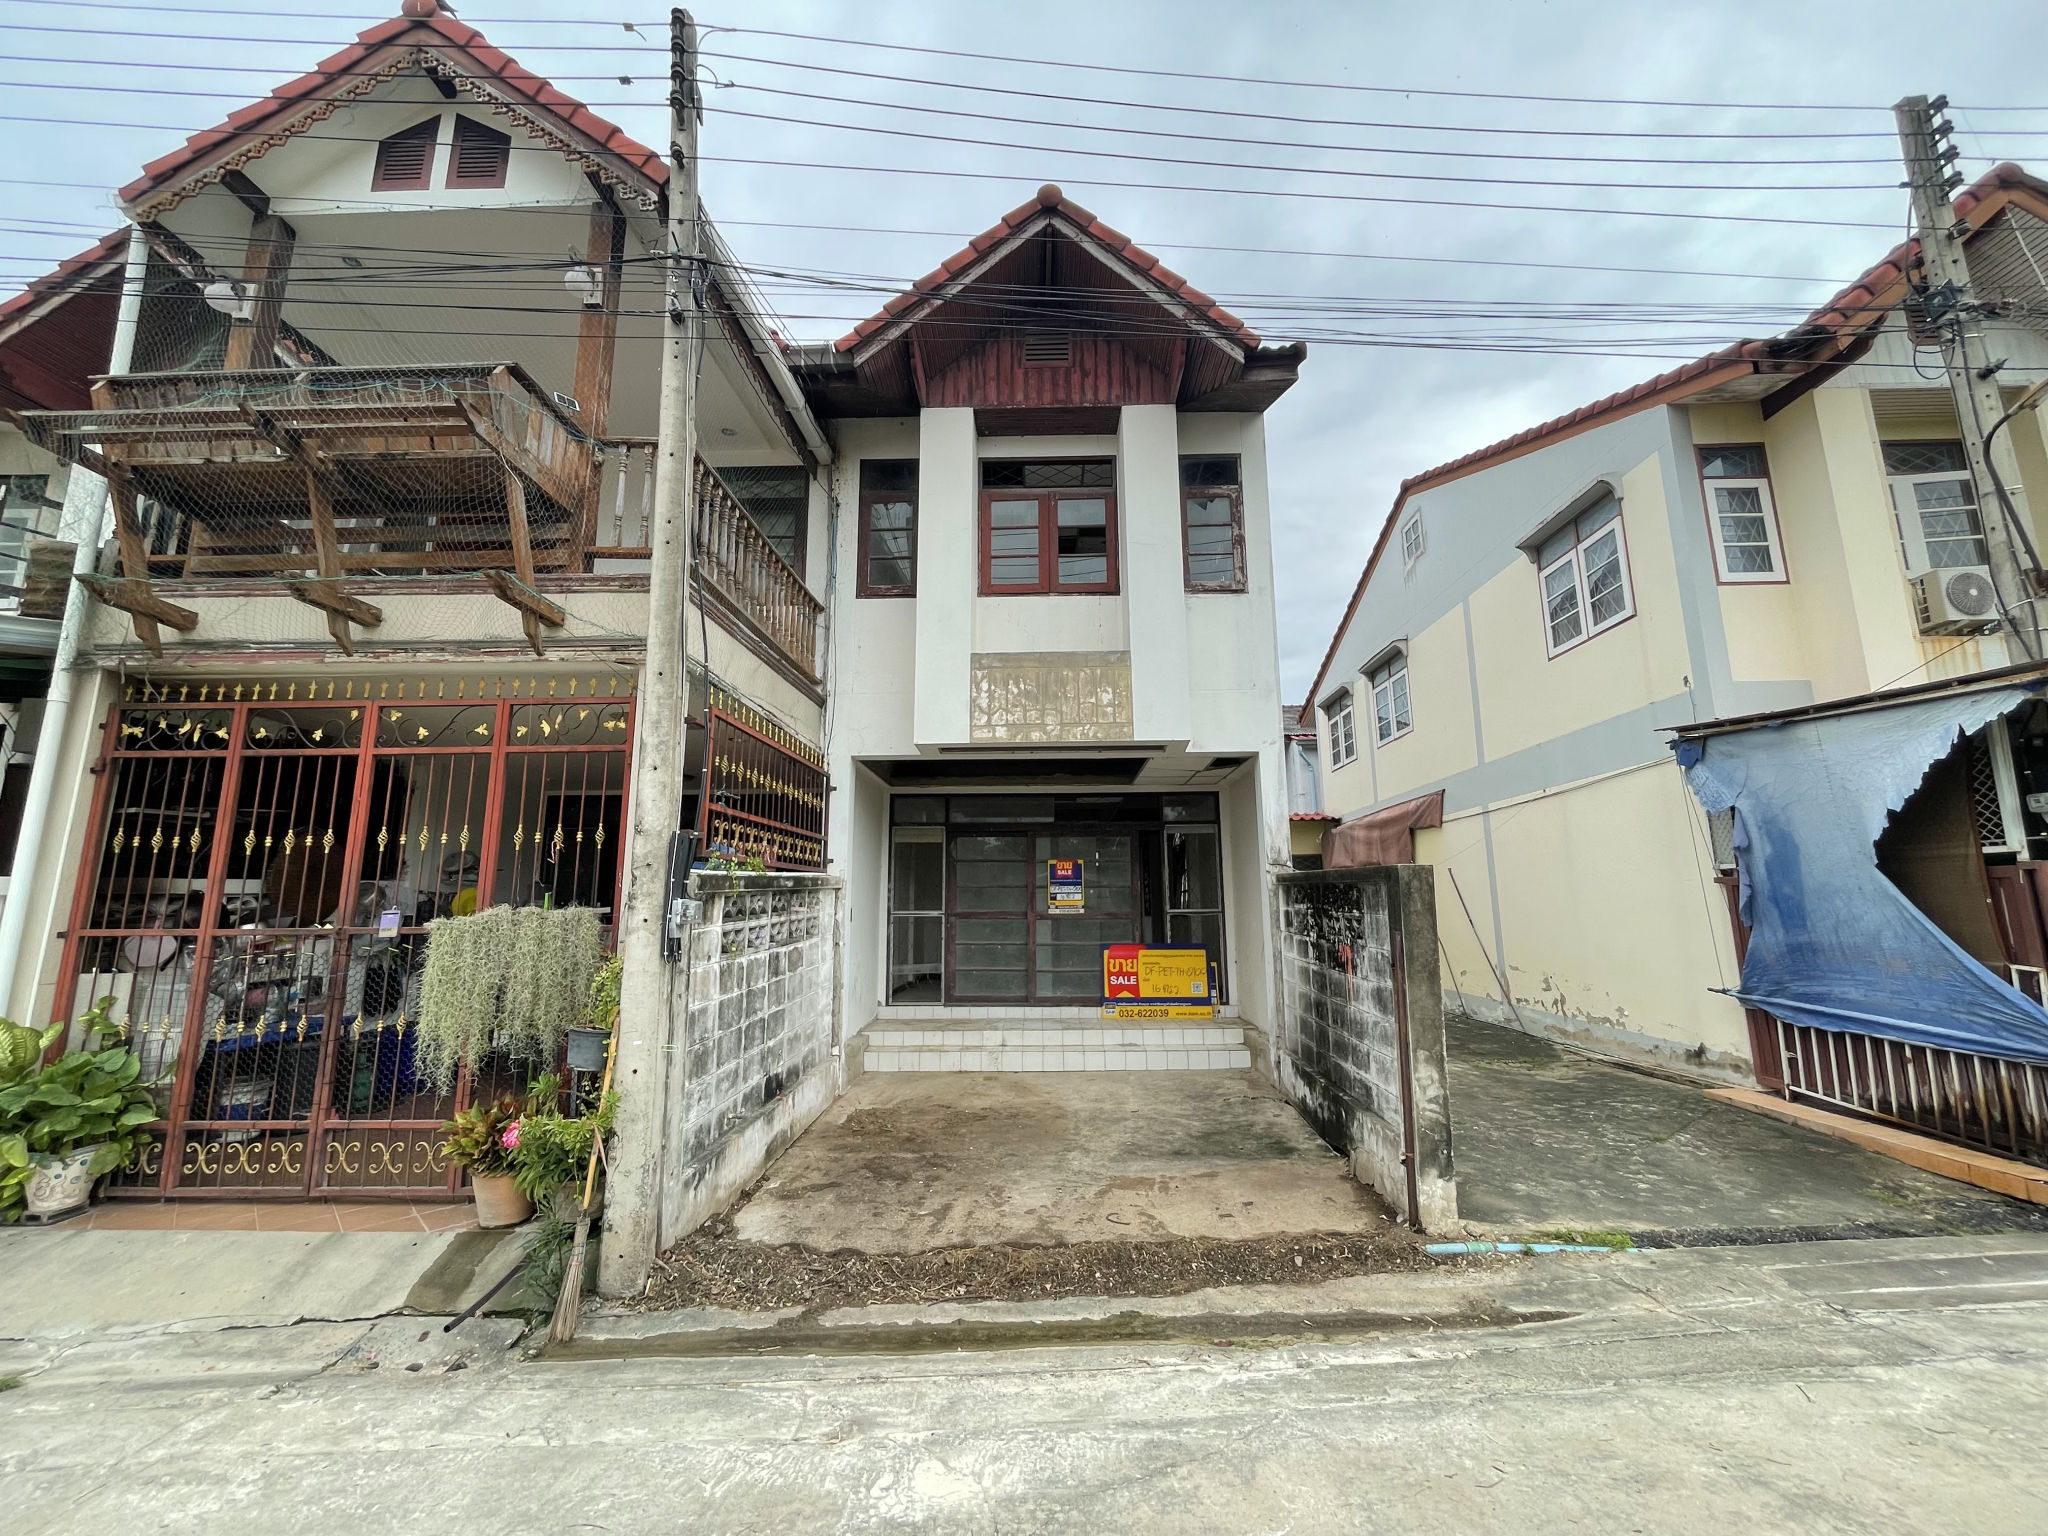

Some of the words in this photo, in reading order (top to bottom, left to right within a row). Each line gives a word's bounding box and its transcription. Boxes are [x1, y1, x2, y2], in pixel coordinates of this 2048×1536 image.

[1057, 861, 1072, 869] ขาย
[1109, 958, 1137, 973] ขาย
[1110, 975, 1137, 985] SALE
[1118, 1009, 1169, 1018] 032-622039
